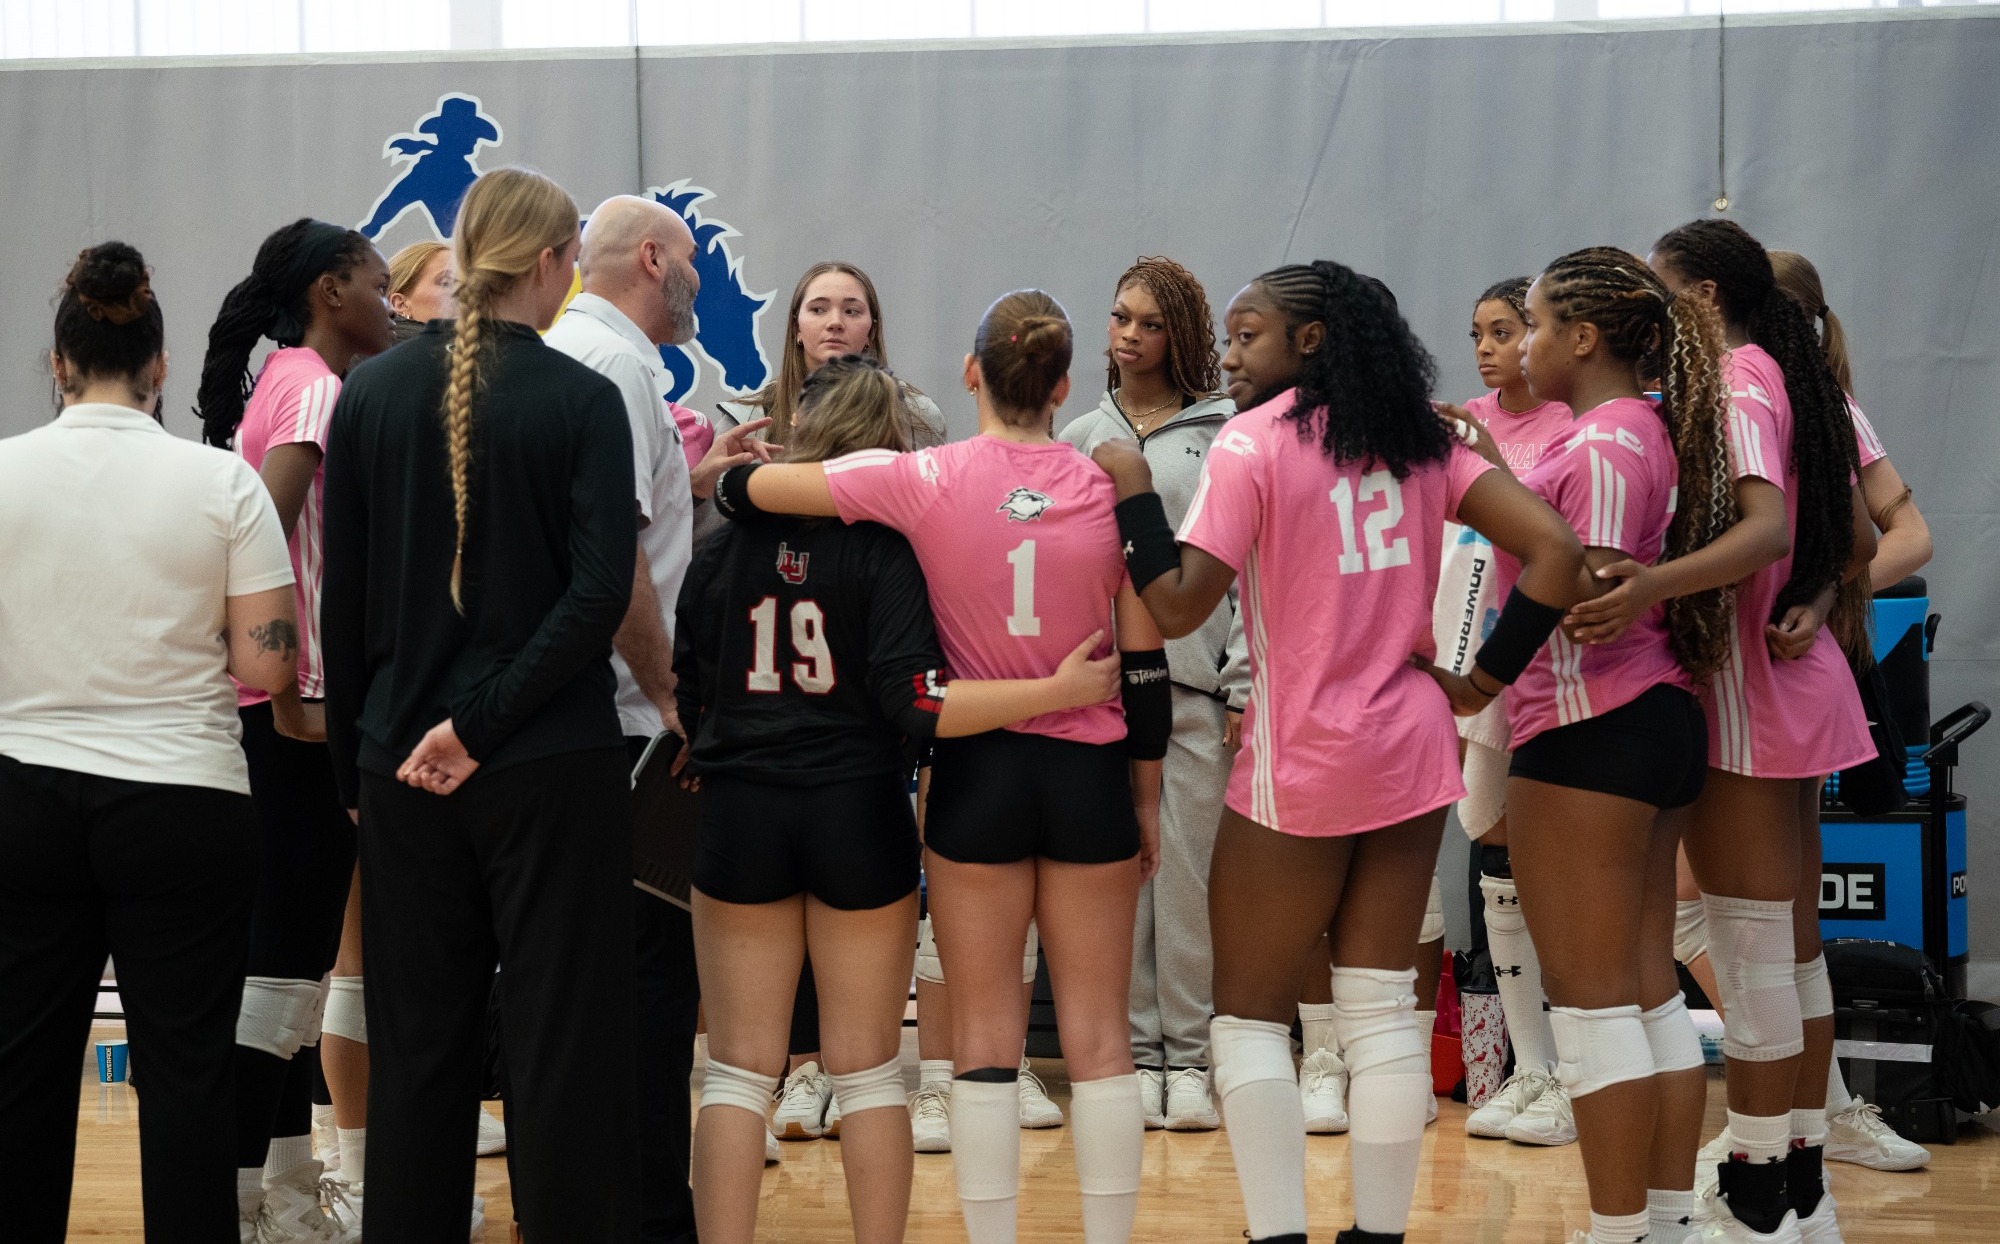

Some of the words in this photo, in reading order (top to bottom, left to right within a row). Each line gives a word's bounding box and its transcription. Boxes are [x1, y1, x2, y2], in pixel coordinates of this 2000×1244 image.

[776, 541, 810, 584] LU
[1329, 469, 1411, 575] 12
[1006, 539, 1041, 636] 1
[1453, 558, 1486, 676] POWERADE
[746, 597, 837, 695] 19
